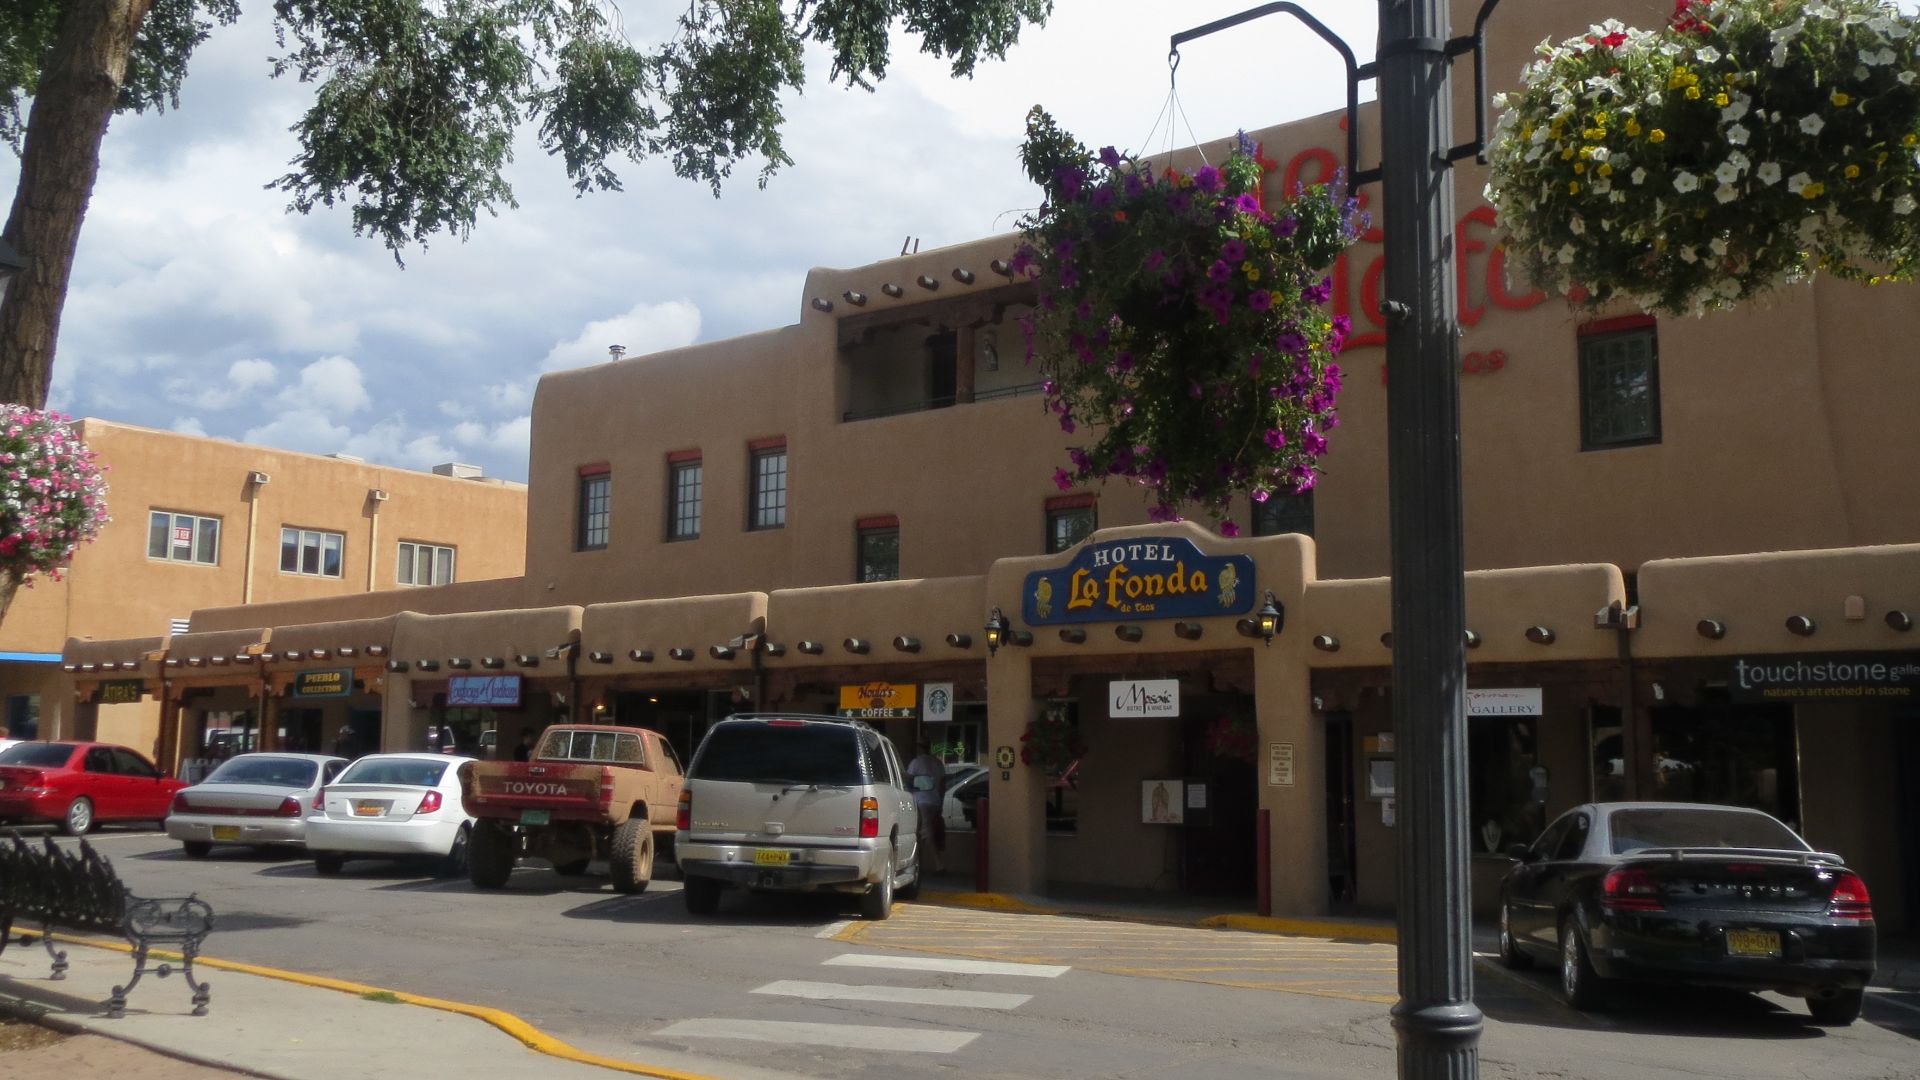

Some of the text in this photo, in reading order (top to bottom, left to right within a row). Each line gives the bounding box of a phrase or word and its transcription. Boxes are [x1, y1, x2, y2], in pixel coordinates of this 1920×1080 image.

[1093, 544, 1175, 567] HOTEL
[1067, 567, 1100, 609] La
[1120, 603, 1156, 613] de Taos
[1736, 659, 1886, 689] touchstone
[1763, 685, 1910, 697] nature's art etched in stone
[1116, 683, 1172, 714] Mosaic
[861, 708, 894, 717] COFFEE
[1472, 705, 1534, 713] GALLERY
[503, 781, 567, 795] TOYOTA
